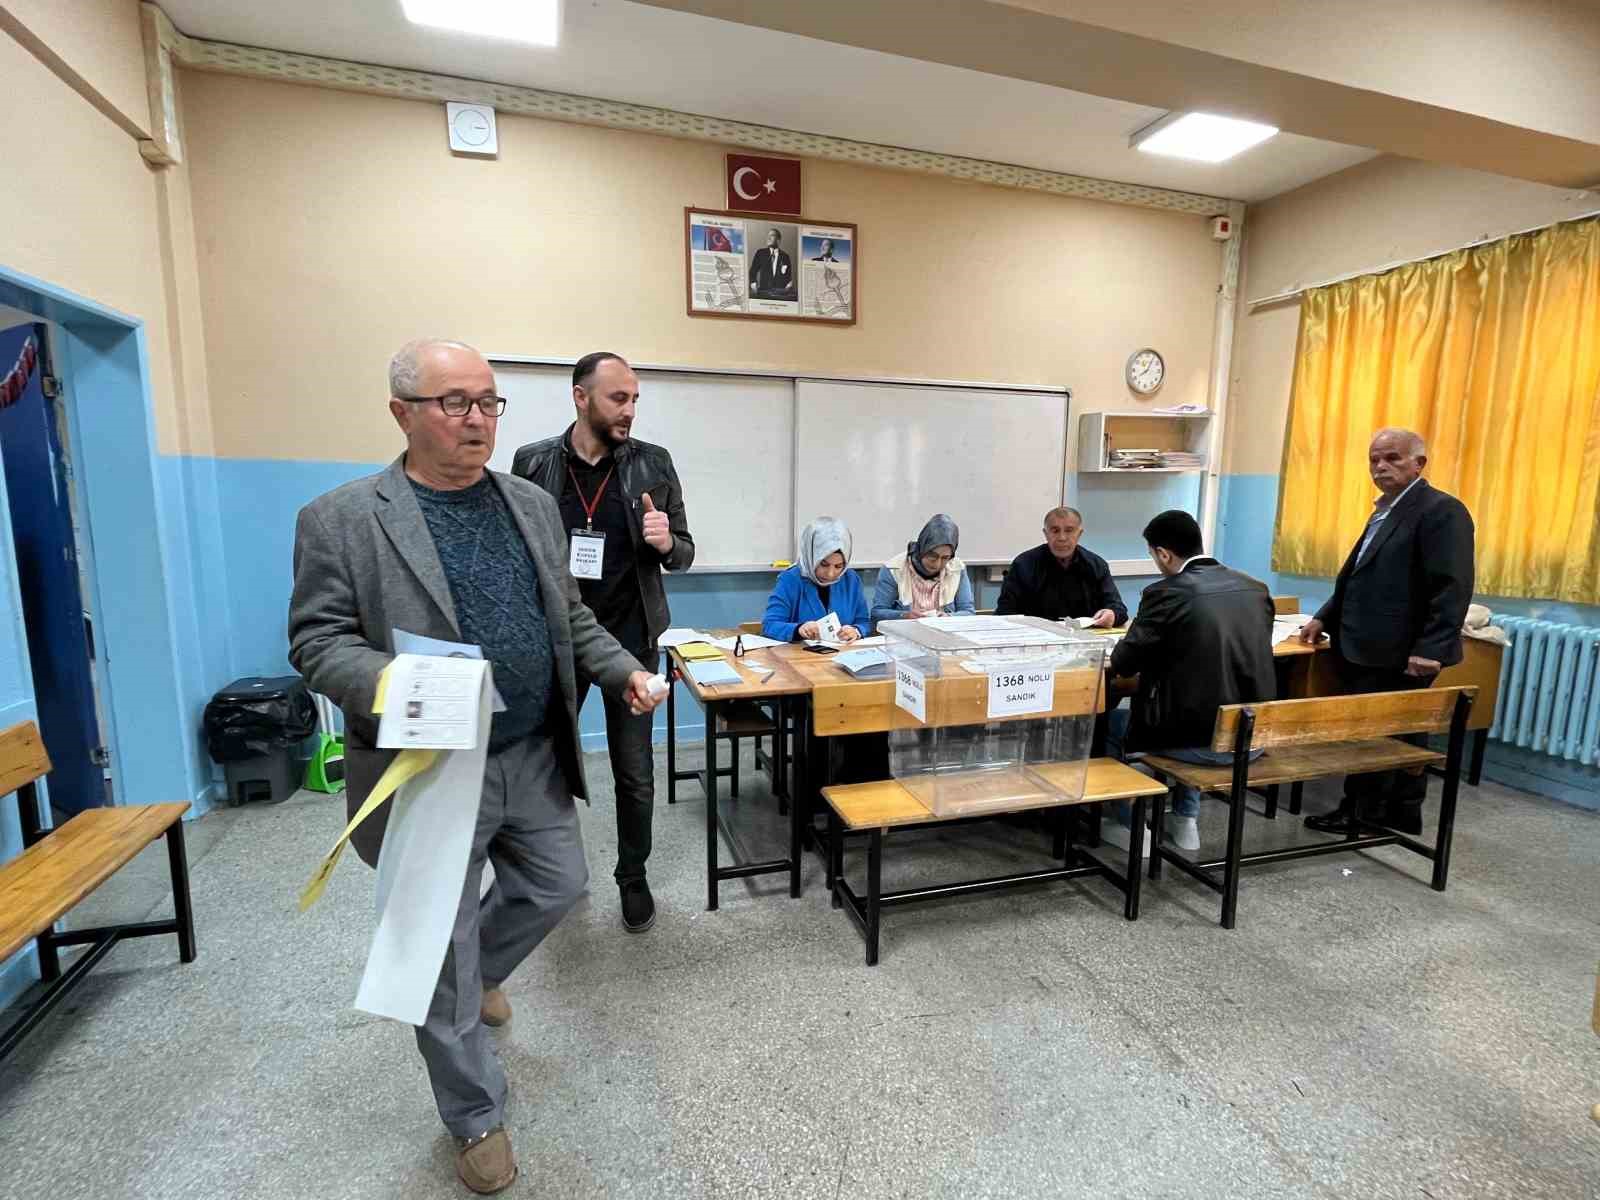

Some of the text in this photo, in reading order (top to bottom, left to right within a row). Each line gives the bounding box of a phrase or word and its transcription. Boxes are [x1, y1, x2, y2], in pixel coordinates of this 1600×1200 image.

[996, 672, 1050, 688] 1368 NOLU
[1006, 692, 1036, 703] SANDIK
